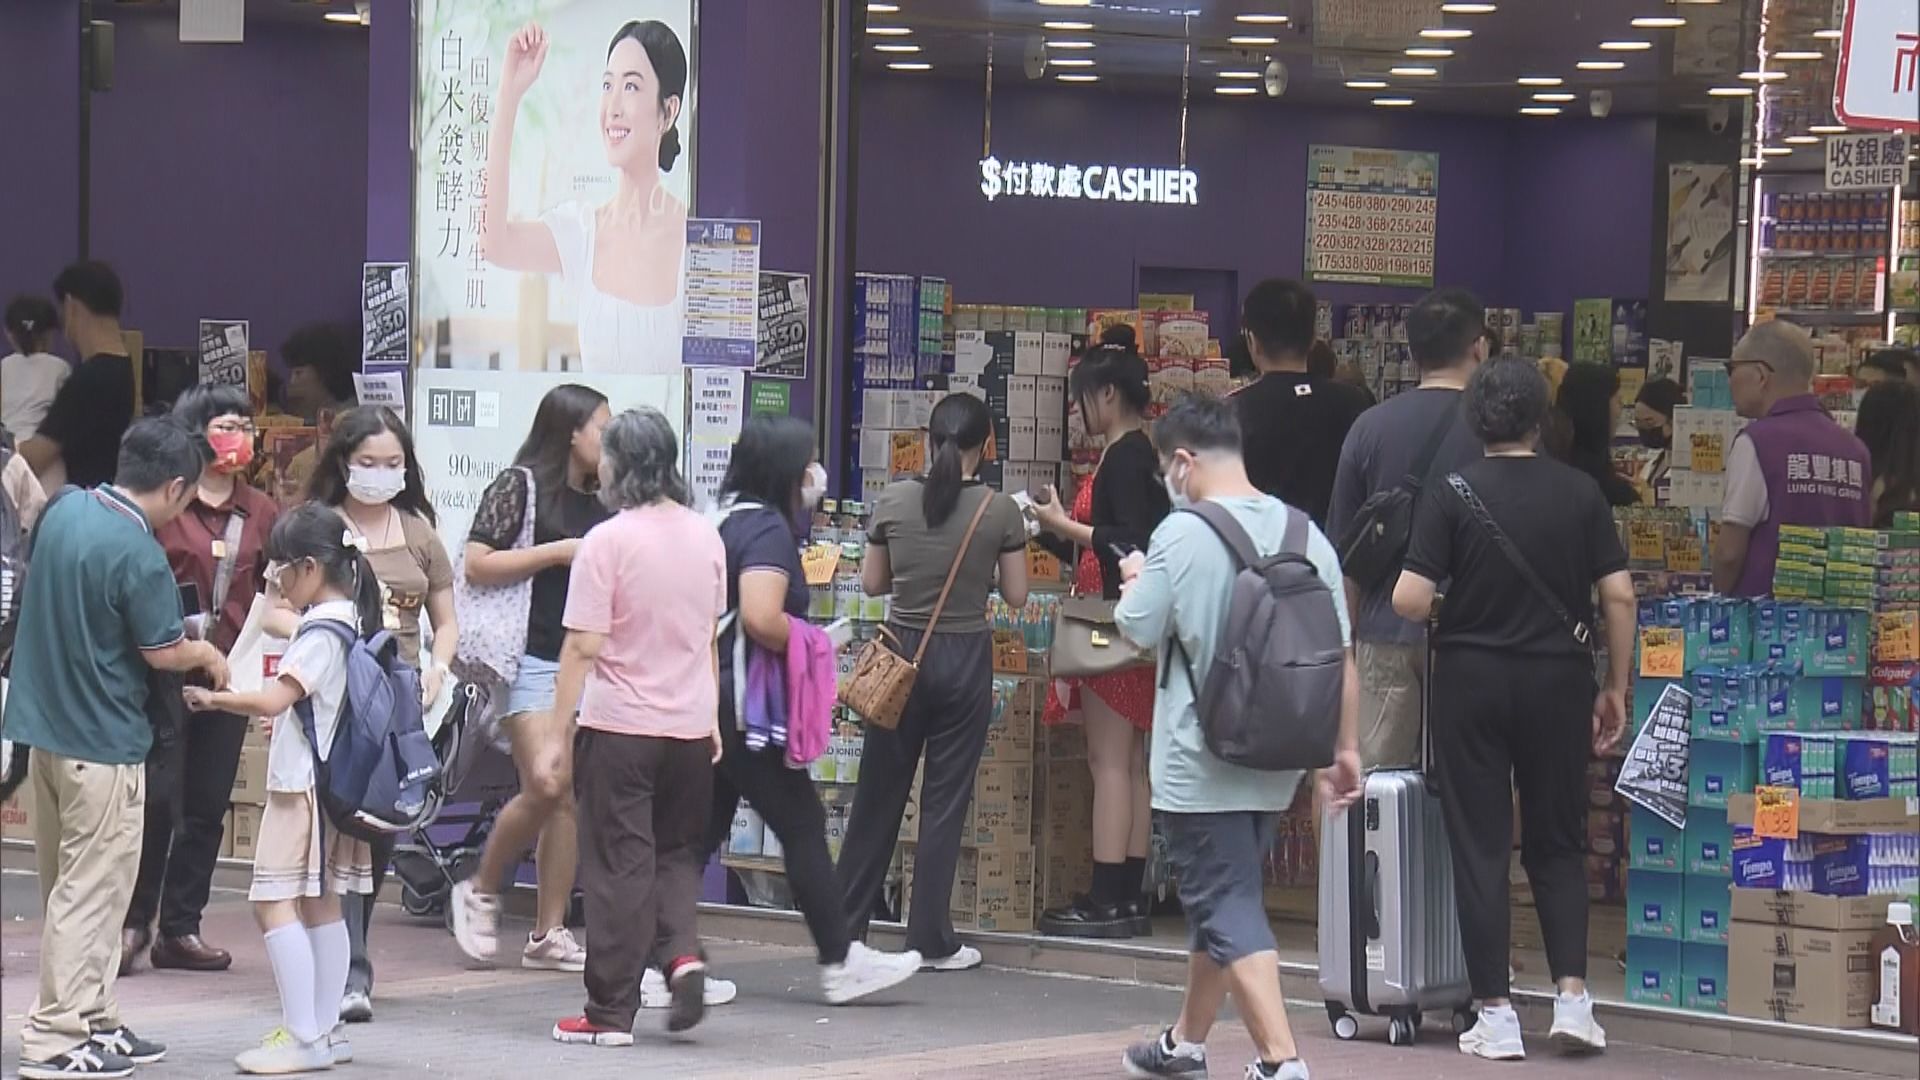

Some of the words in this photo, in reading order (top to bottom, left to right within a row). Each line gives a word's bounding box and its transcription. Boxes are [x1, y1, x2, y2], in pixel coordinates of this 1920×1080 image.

[436, 30, 464, 259] 白米發酵力
[1831, 138, 1905, 168] 收銀處
[1083, 166, 1198, 205] CASHIER
[1831, 168, 1904, 187] CASHIER
[1318, 193, 1338, 208] 245
[1342, 195, 1362, 209] 468
[1366, 196, 1386, 211] 380
[1391, 198, 1411, 213] 290
[1415, 200, 1435, 214] 245
[1318, 214, 1338, 228] 235
[1342, 215, 1361, 229] 428
[1366, 216, 1387, 231] 368
[1390, 218, 1411, 232] 255
[1415, 220, 1435, 234] 240
[1316, 234, 1336, 249] 220
[1340, 235, 1360, 249] 382
[1365, 236, 1385, 251] 328
[1389, 238, 1409, 253] 232
[1414, 240, 1433, 254] 215
[1318, 254, 1338, 268] 175
[1339, 255, 1359, 270] 338
[1363, 256, 1384, 271] 308
[1389, 258, 1409, 272] 198
[1413, 260, 1432, 274] 195
[433, 394, 471, 422] 肌研
[1787, 453, 1863, 488] 龍豐集團
[1787, 483, 1816, 494] LUNG
[1871, 666, 1913, 679] Colgate
[1848, 772, 1879, 786] Tempo
[1740, 858, 1774, 876] Tempo
[1824, 863, 1858, 881] Tempo
